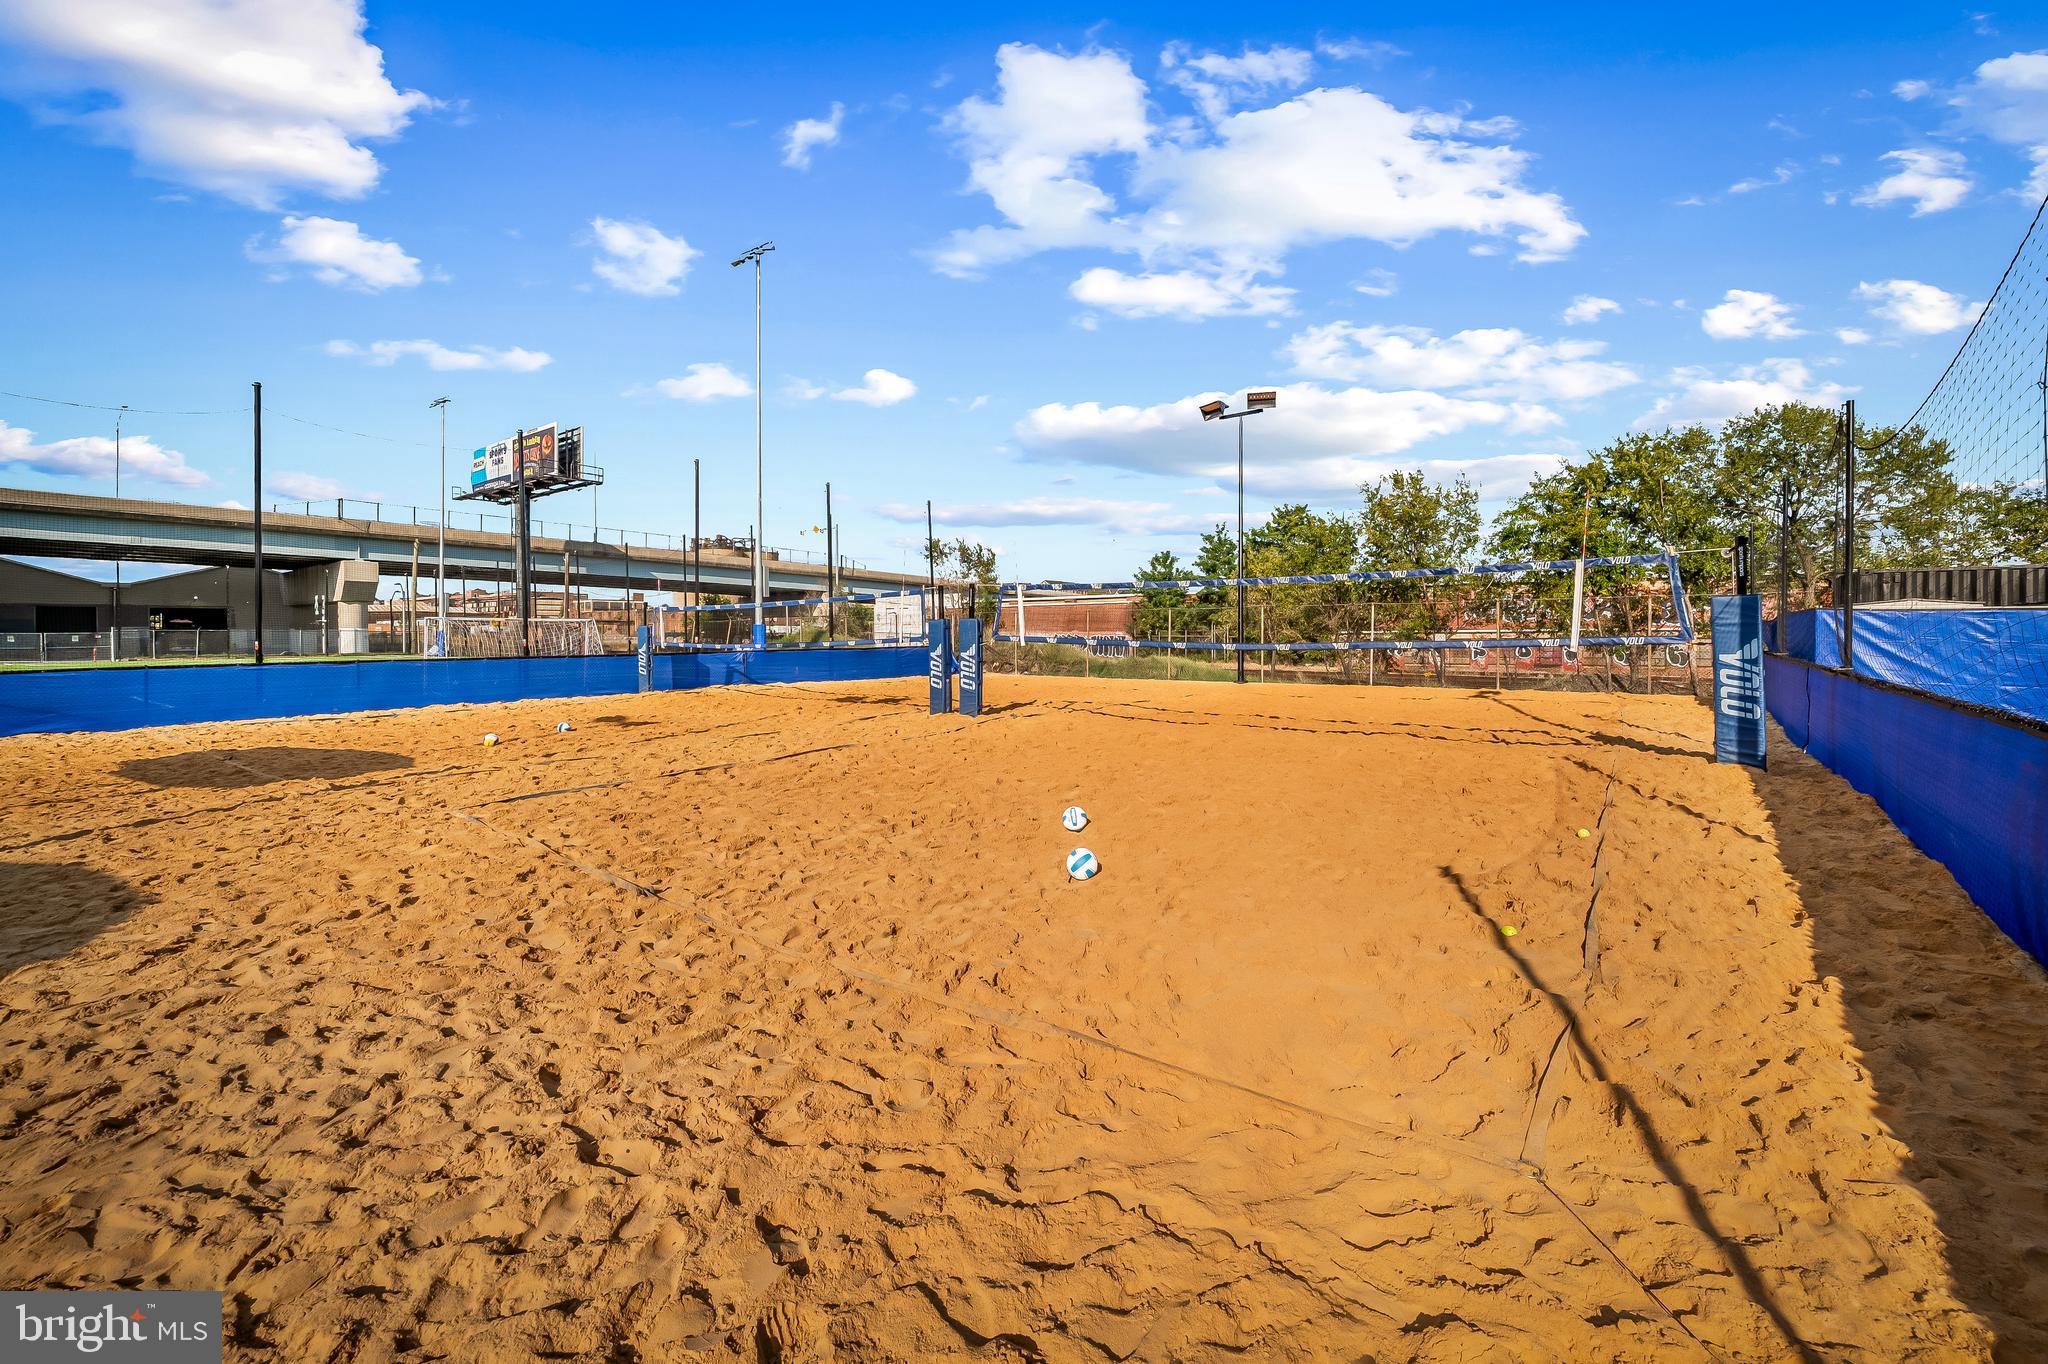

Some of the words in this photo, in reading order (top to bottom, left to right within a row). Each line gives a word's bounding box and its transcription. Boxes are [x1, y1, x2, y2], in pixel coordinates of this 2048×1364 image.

[1456, 566, 1474, 574] VOLO
[1530, 562, 1550, 570] VOLO
[1610, 556, 1631, 565] VOLO
[638, 642, 647, 675] VOLO
[1538, 639, 1560, 647] VOLO
[1621, 637, 1645, 645] VOLO
[930, 643, 942, 689] VOLO
[960, 643, 976, 690] VOLO
[1719, 637, 1761, 720] VOLO
